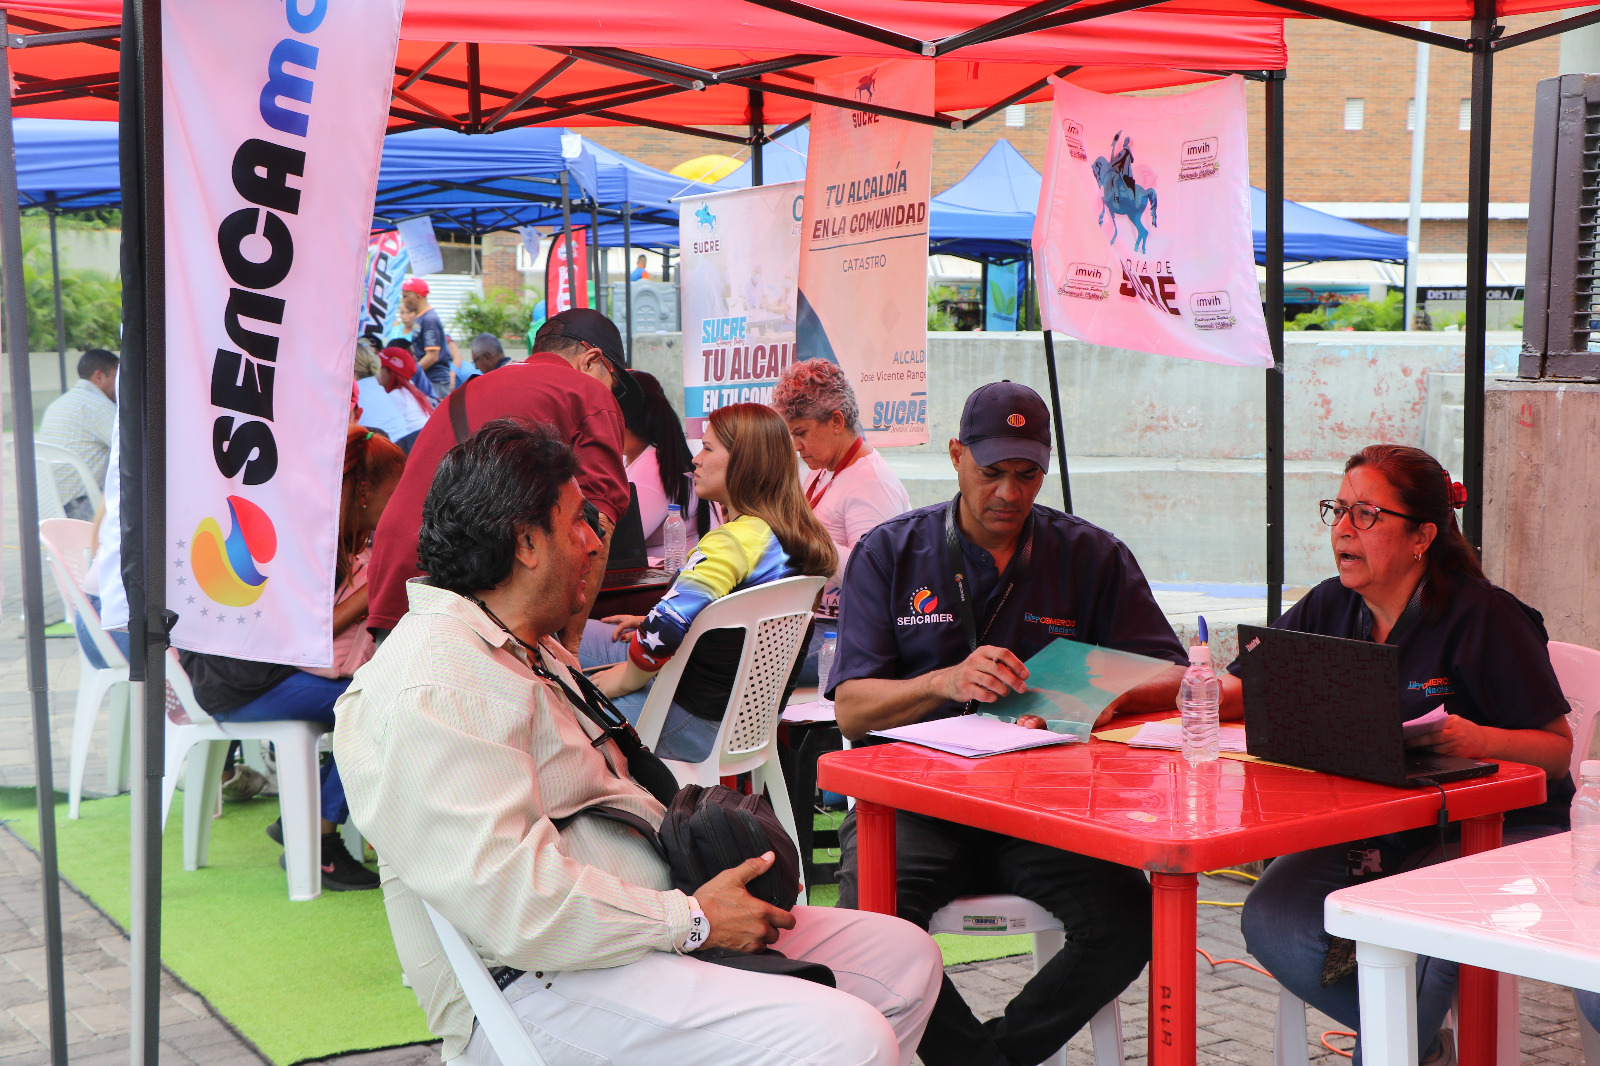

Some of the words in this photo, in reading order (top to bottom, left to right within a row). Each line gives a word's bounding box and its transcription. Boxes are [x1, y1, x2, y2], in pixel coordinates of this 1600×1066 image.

[1187, 142, 1210, 155] imvih
[826, 183, 846, 207] TU
[847, 161, 907, 204] ALCALDÍA
[812, 218, 830, 240] EN
[831, 215, 847, 237] LA
[849, 201, 926, 235] COMUNIDAD
[693, 239, 720, 254] SUCRE
[842, 254, 887, 273] CATASTRO
[1075, 265, 1102, 279] imvih
[1196, 295, 1221, 307] imvih
[702, 316, 747, 344] SUCRE
[702, 348, 727, 382] TU
[860, 372, 875, 382] José
[876, 370, 905, 381] Vicente
[702, 389, 720, 413] EN
[741, 386, 777, 407] COM
[873, 399, 927, 426] SUCRE
[897, 613, 954, 626] SENCAMER
[690, 932, 702, 942] 12
